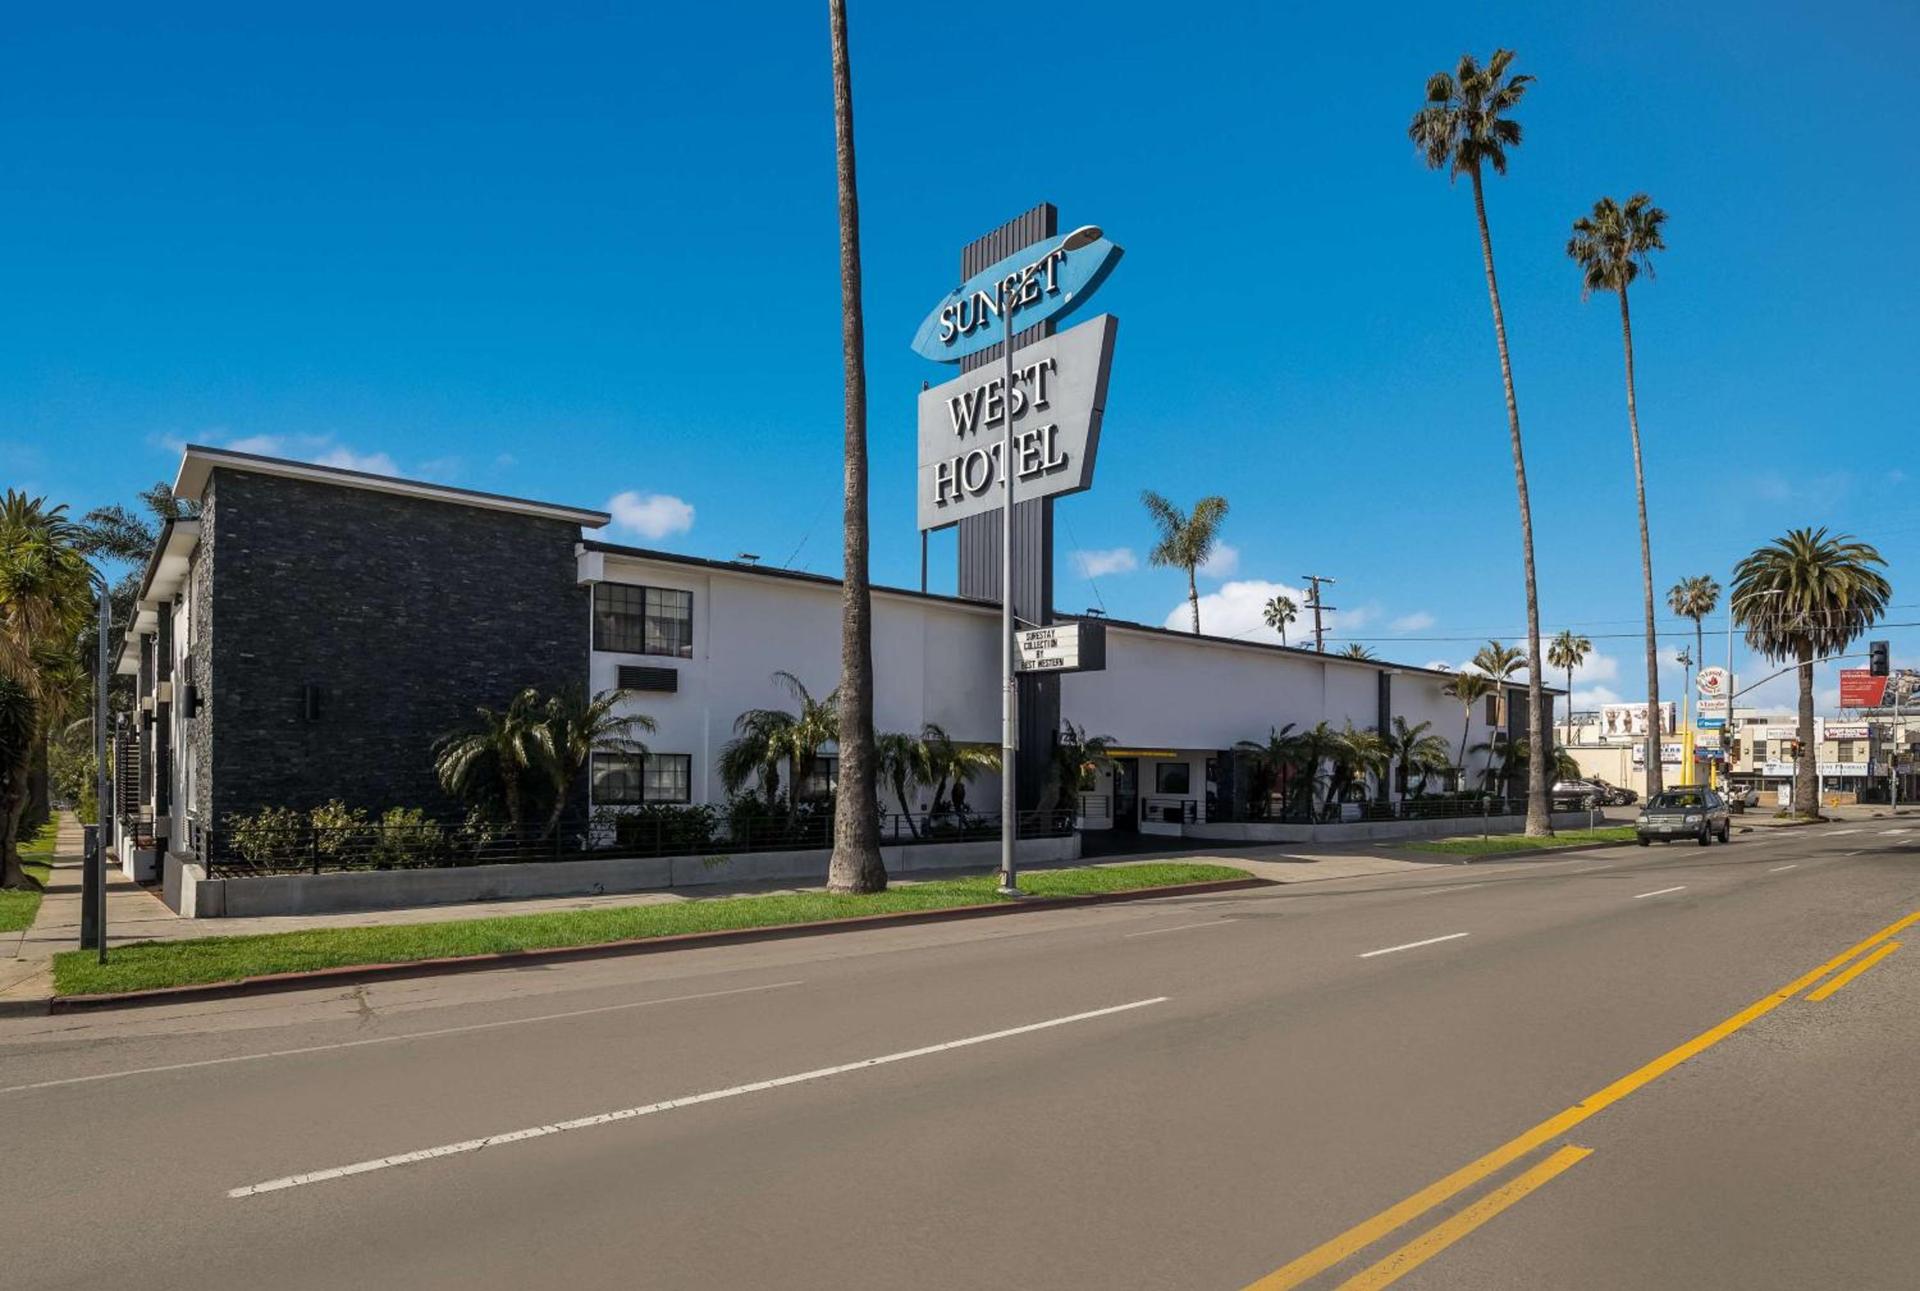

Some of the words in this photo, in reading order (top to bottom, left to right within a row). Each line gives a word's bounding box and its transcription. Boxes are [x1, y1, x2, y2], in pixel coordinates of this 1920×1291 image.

[938, 251, 1062, 342] SUNSET
[945, 358, 1052, 435] WEST
[933, 424, 1063, 503] HOTEL
[1026, 629, 1056, 641] SURESTAY
[1024, 639, 1057, 650] COLLECTION
[1036, 650, 1044, 659] BY
[1021, 660, 1036, 670] BEST
[1037, 658, 1064, 667] WESTERN
